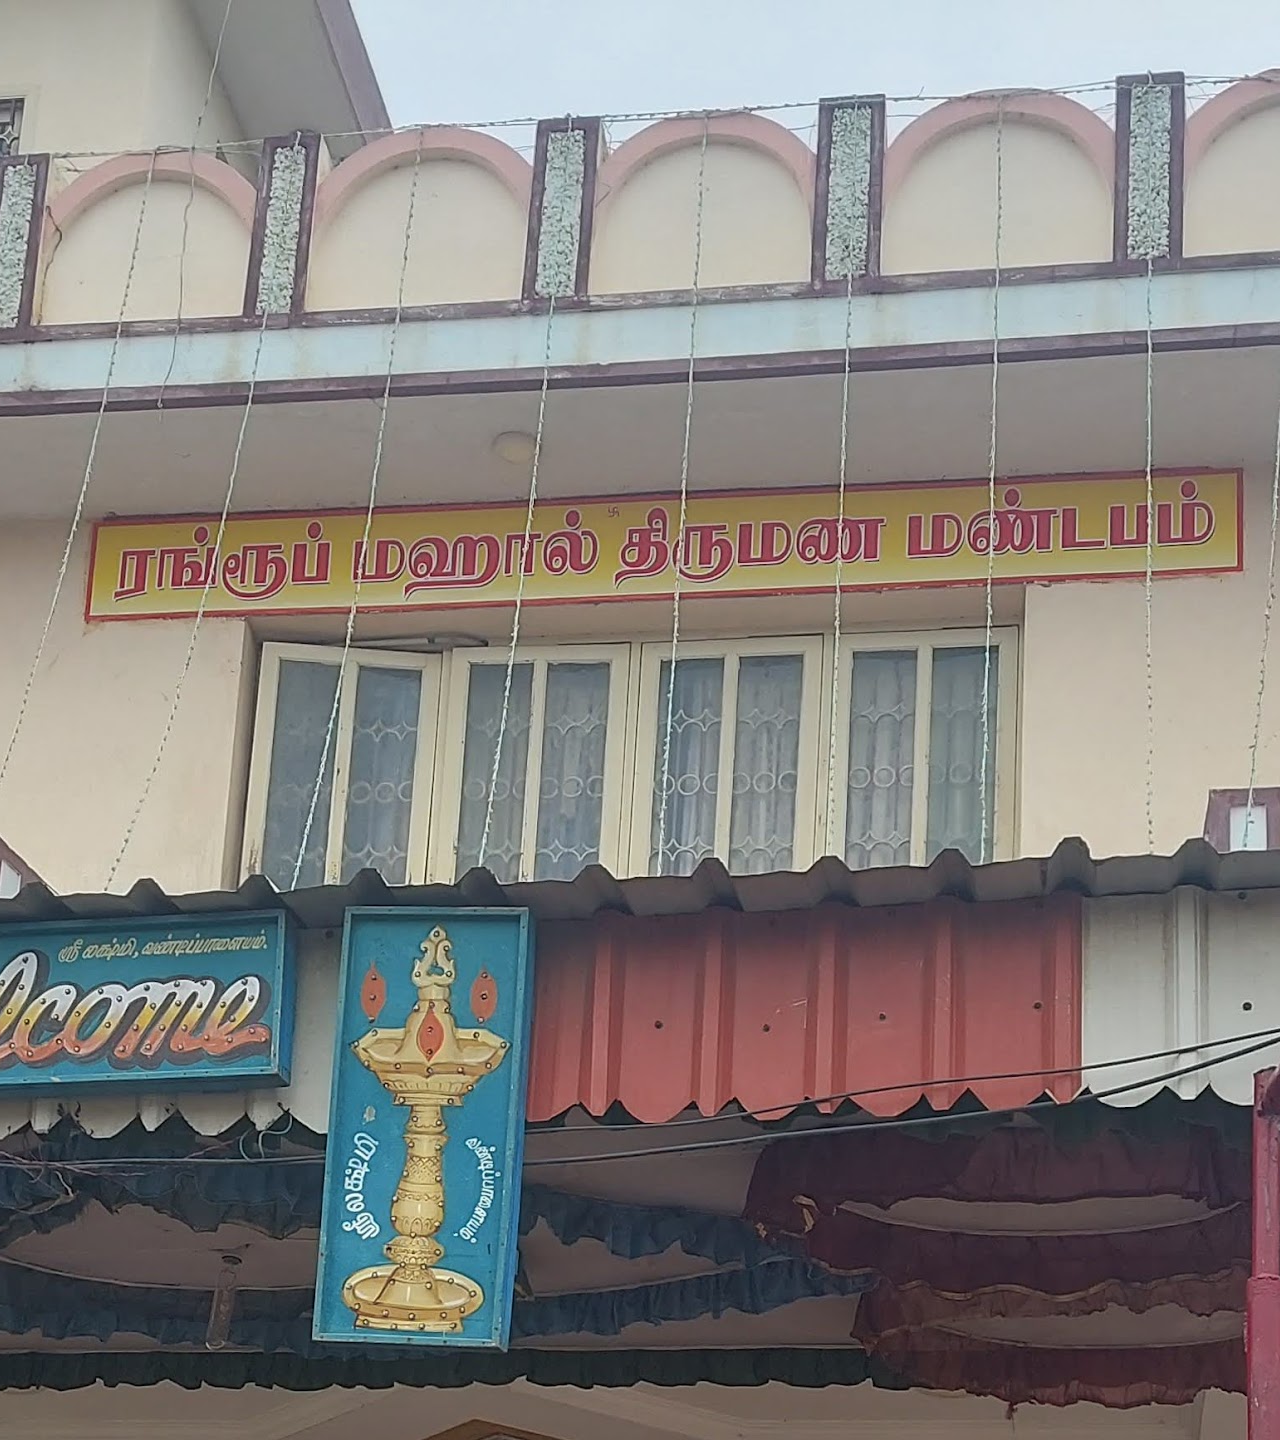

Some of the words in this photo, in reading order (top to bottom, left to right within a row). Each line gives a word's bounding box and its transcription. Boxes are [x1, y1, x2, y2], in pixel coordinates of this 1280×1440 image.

[351, 508, 600, 599] மஹால்
[613, 506, 886, 588] திருமண
[906, 478, 1216, 560] மண்டபம்
